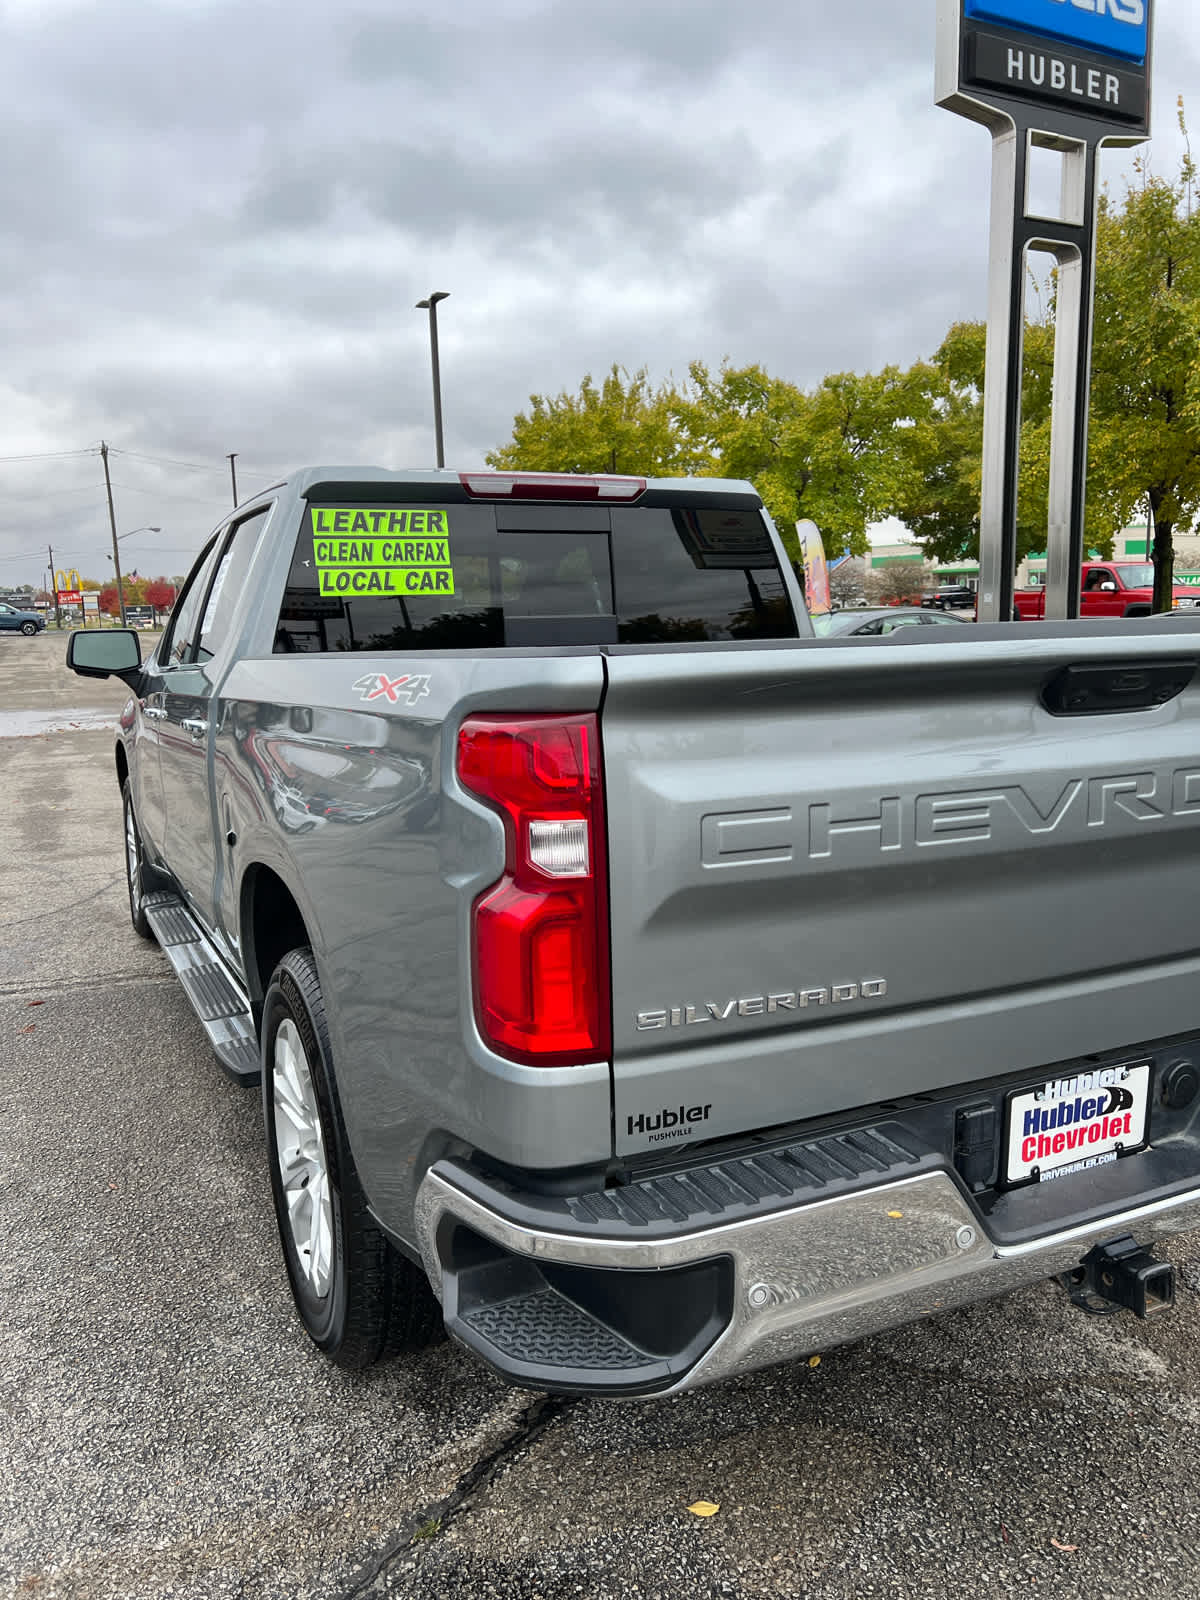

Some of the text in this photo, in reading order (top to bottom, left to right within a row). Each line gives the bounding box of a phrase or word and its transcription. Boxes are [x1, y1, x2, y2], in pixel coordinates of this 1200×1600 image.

[1007, 48, 1119, 105] HUBLER
[315, 511, 444, 533] LEATHER
[316, 542, 447, 562] CLEAN CARFAX
[322, 570, 450, 592] LOCAL CAR
[636, 978, 887, 1031] SILVERADO
[1044, 1066, 1127, 1099] Hubler
[627, 1104, 712, 1135] Hubler
[1023, 1094, 1109, 1136] Hubler
[1021, 1112, 1132, 1163] Chevrolet
[1040, 1152, 1117, 1183] DRIVEHUBLER.COM
